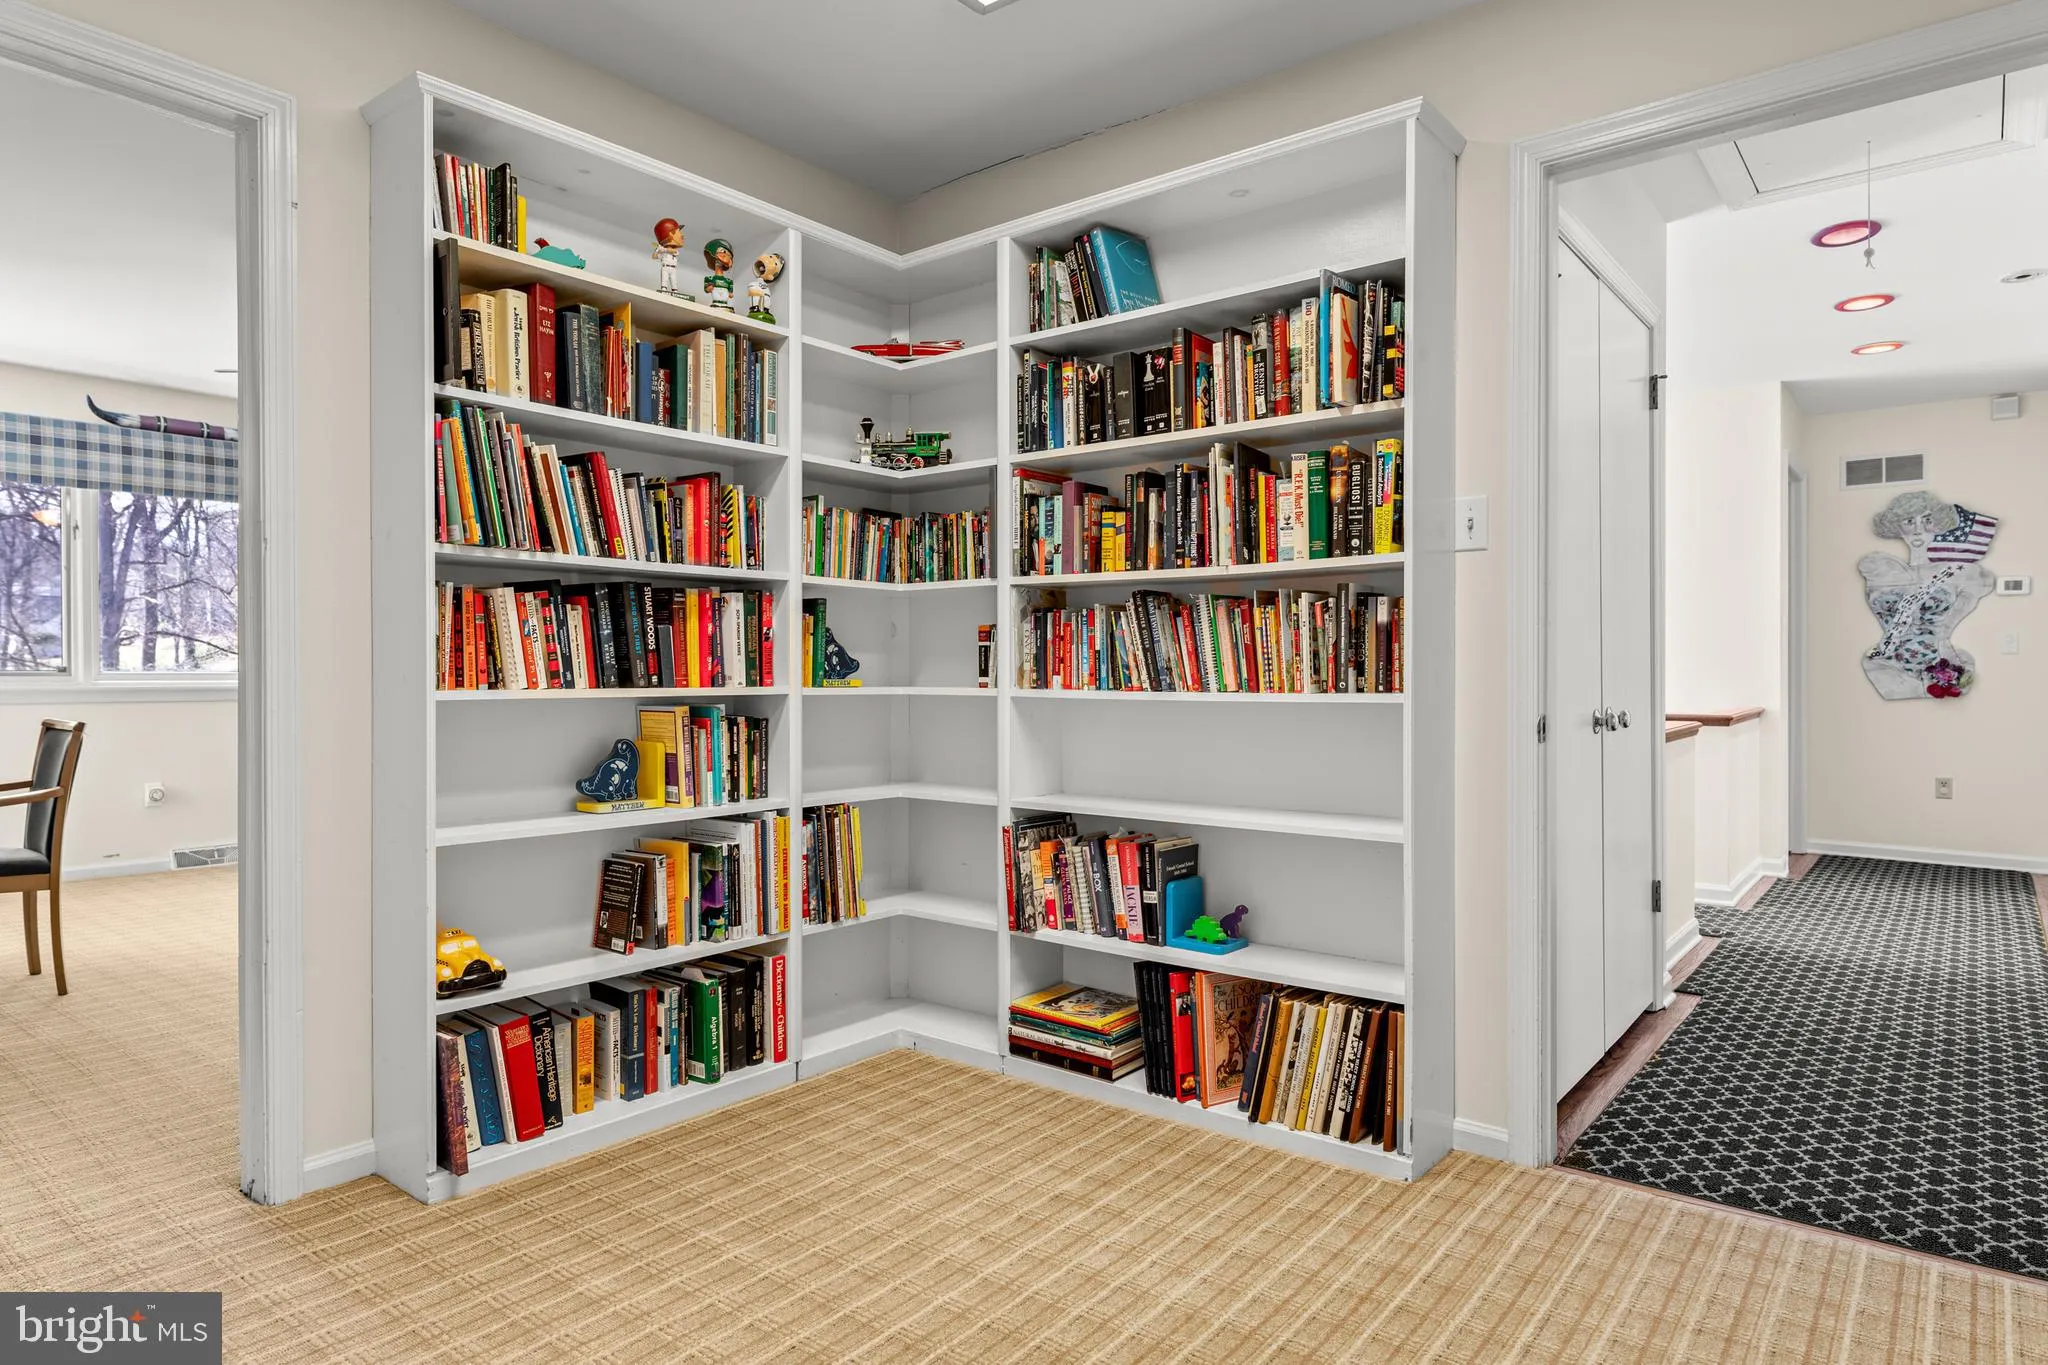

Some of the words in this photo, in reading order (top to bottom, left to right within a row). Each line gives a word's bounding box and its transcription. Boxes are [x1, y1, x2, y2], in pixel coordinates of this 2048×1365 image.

[1332, 274, 1356, 294] ROMEO
[1274, 328, 1280, 336] DA
[1352, 464, 1360, 504] BUGLIOSI
[1294, 493, 1303, 510] Must
[644, 586, 652, 615] STUART
[1148, 602, 1155, 614] AM
[1137, 607, 1145, 627] WINTER
[1149, 615, 1159, 641] JEWISH
[647, 617, 656, 650] WOODS
[1185, 627, 1193, 652] Daughter
[1093, 873, 1102, 892] BOX
[1126, 887, 1138, 926] JACKIE
[775, 959, 784, 1010] Dictionary
[775, 1015, 784, 1052] Children
[1013, 1030, 1036, 1040] NATURAL
[534, 1035, 545, 1077] Dictionary
[542, 1027, 553, 1067] American
[1355, 1040, 1363, 1058] FRIENDS
[1333, 1063, 1341, 1079] FRIENDS
[1349, 1074, 1357, 1091] SCHOOL
[547, 1067, 556, 1102] Heritage
